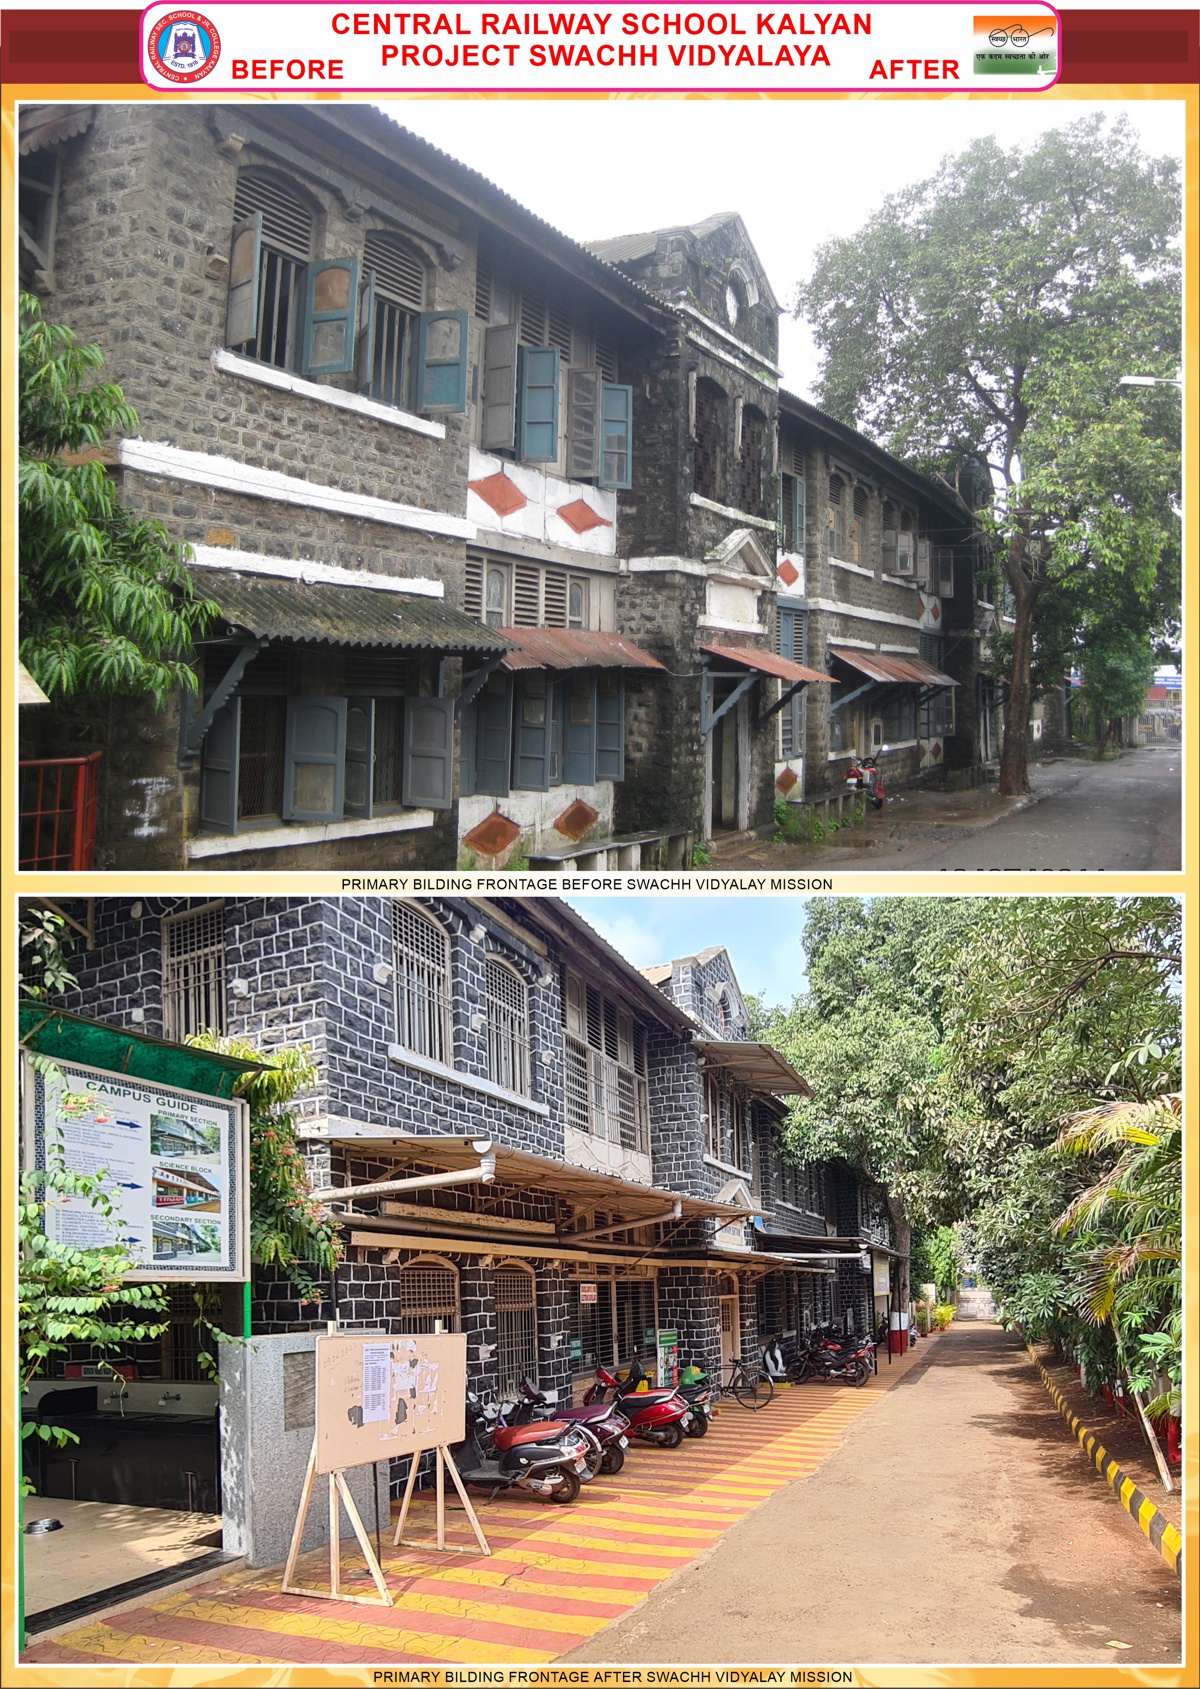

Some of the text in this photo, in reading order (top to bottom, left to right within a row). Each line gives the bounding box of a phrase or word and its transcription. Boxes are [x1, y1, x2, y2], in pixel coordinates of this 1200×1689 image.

[86, 1081, 198, 1114] CAMPUS GUIDE
[157, 1109, 218, 1126] PRIMARY SECTION
[159, 1161, 213, 1174] SCIENCE BLOCK
[150, 1214, 221, 1225] SECONDARY SECTION
